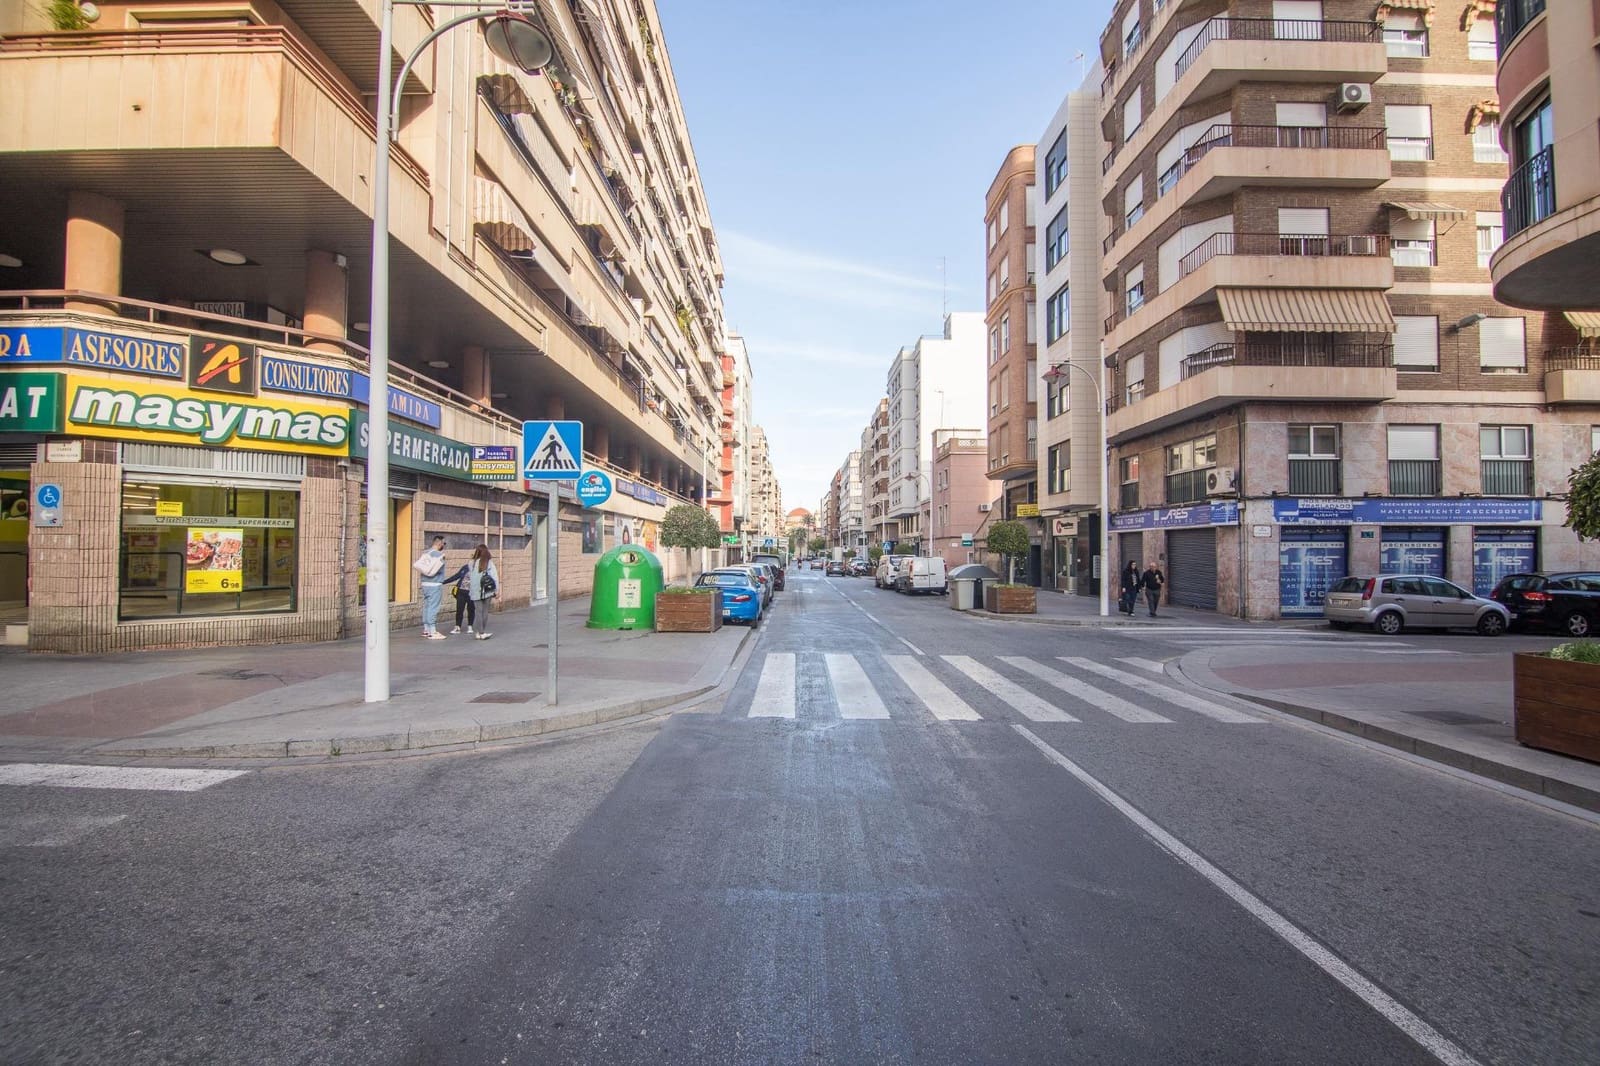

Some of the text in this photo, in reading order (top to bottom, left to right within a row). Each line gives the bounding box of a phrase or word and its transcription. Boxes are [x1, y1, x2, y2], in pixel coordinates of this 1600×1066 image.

[68, 332, 181, 374] ASESORES
[264, 360, 349, 396] CONSULTORES
[70, 386, 350, 445] masymas
[387, 389, 430, 421] AMIDA
[360, 422, 470, 472] SPERMERCADO
[475, 448, 485, 459] P
[1161, 507, 1193, 520] ARES
